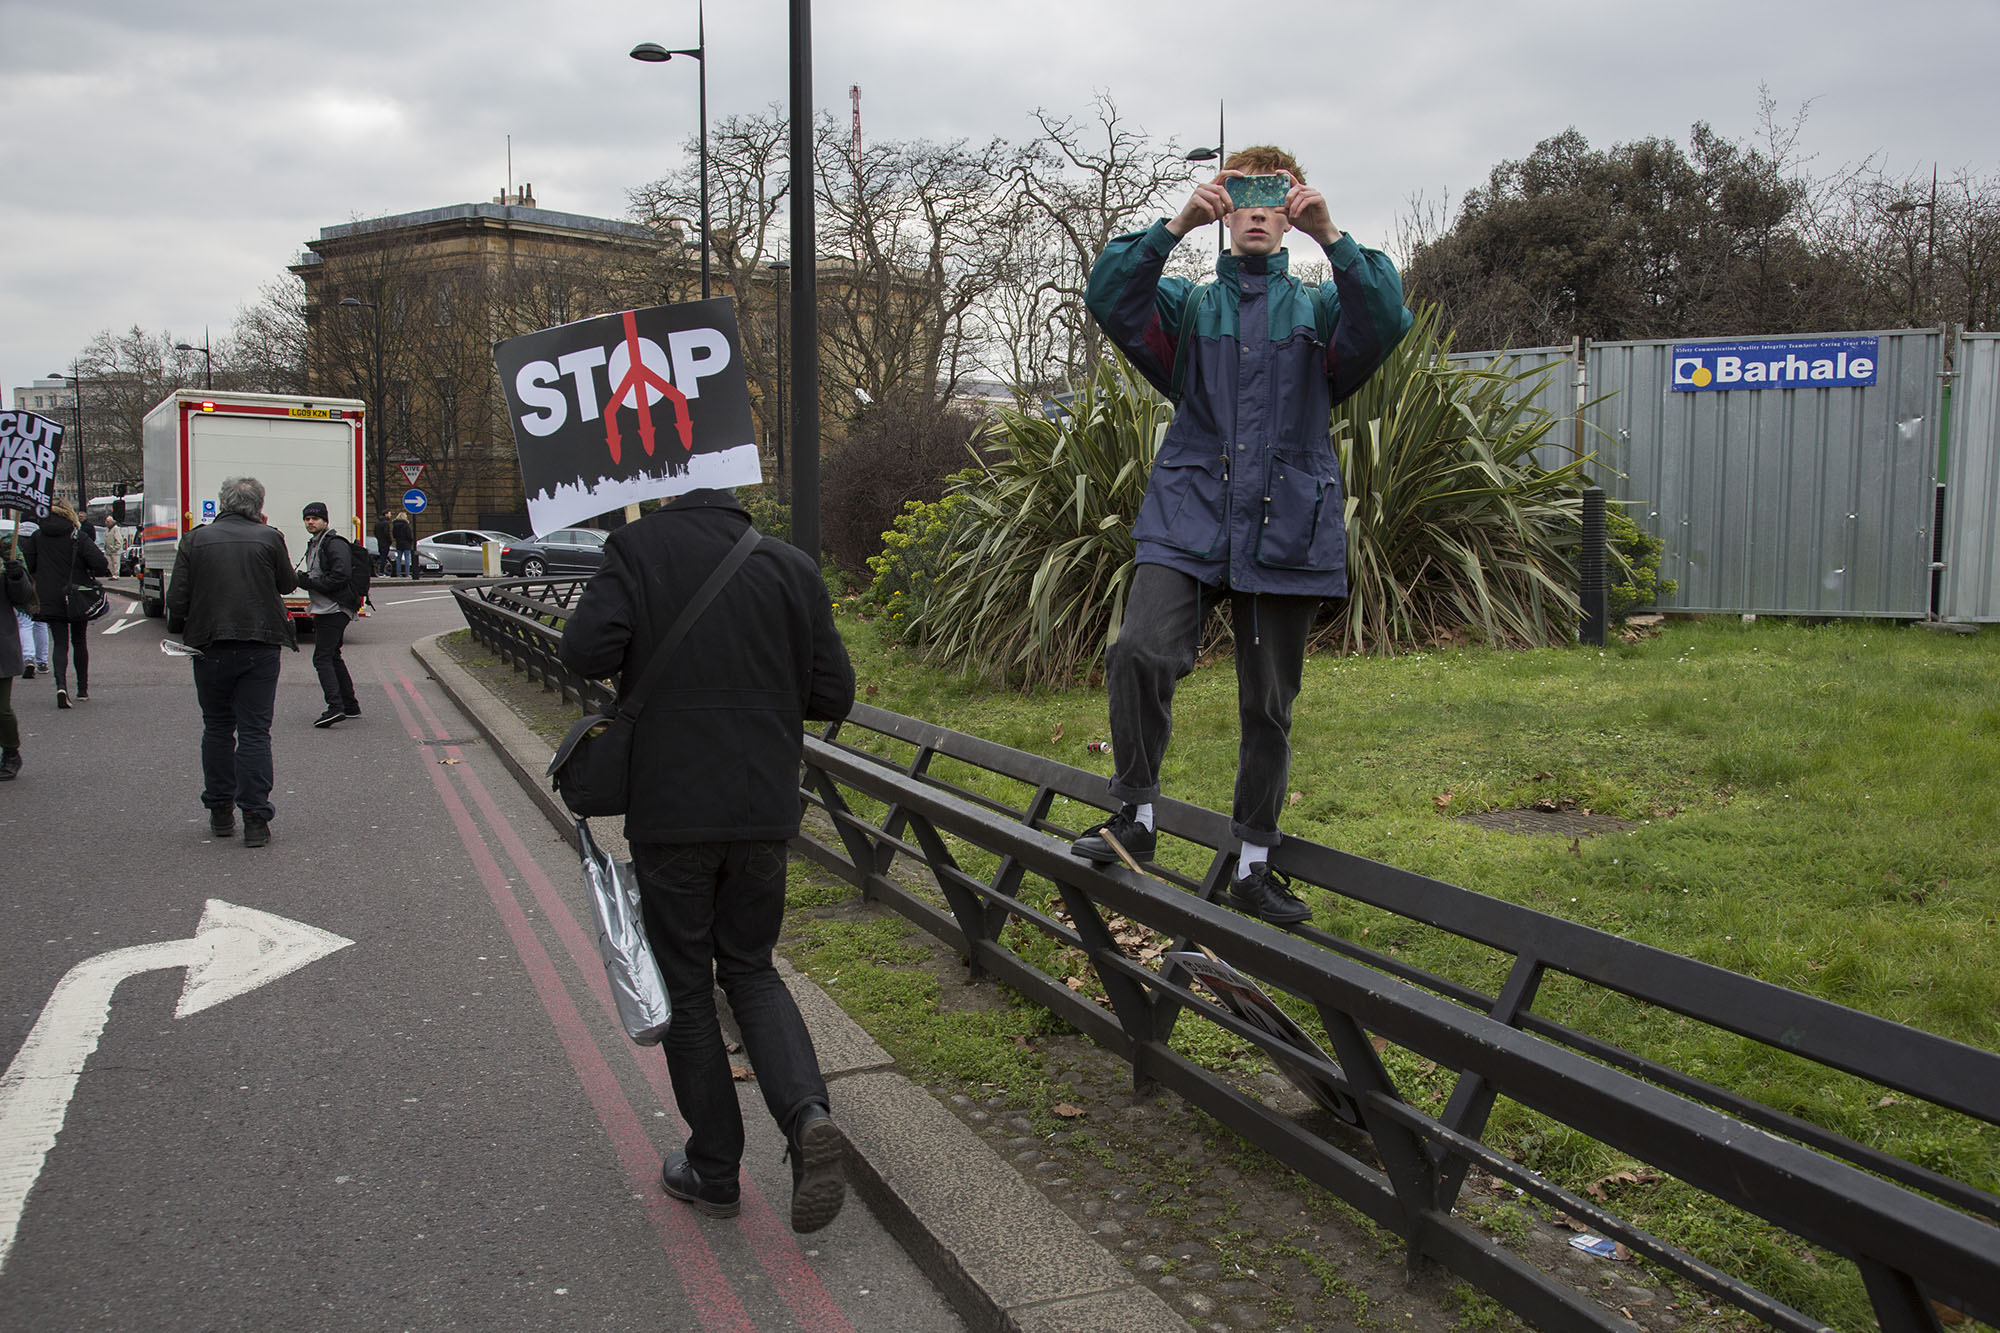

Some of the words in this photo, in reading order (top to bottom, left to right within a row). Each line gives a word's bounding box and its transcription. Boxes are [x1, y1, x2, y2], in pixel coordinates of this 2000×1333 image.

[515, 327, 731, 437] STOP
[1716, 352, 1874, 383] Barhale
[291, 409, 311, 417] LG09
[0, 412, 63, 449] CUT
[0, 436, 56, 473] WAR
[0, 481, 50, 506] ELFARE
